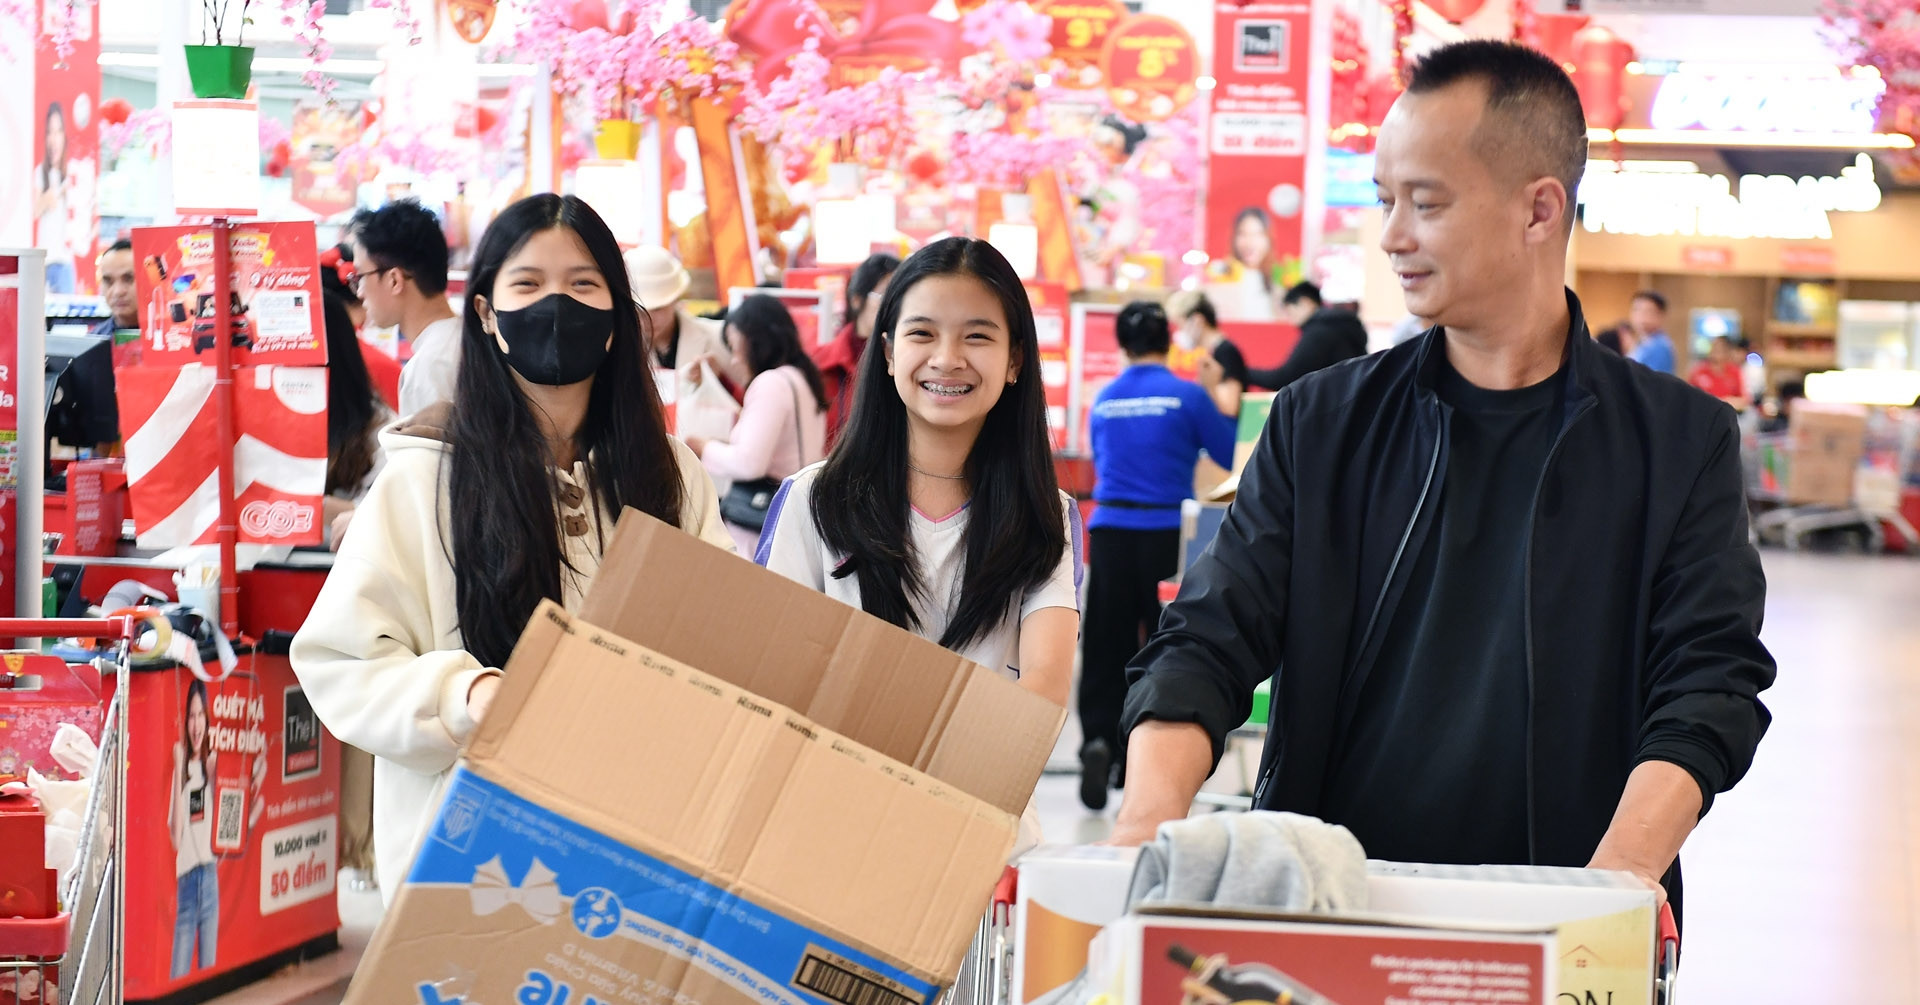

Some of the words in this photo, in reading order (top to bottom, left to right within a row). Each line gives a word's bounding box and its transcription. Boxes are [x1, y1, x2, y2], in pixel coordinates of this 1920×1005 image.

[737, 696, 773, 718] Roma
[208, 721, 236, 752] TÍCH
[274, 835, 303, 859] 10.000
[271, 869, 289, 898] 50
[561, 941, 576, 954] D
[577, 948, 640, 986] Vitamin
